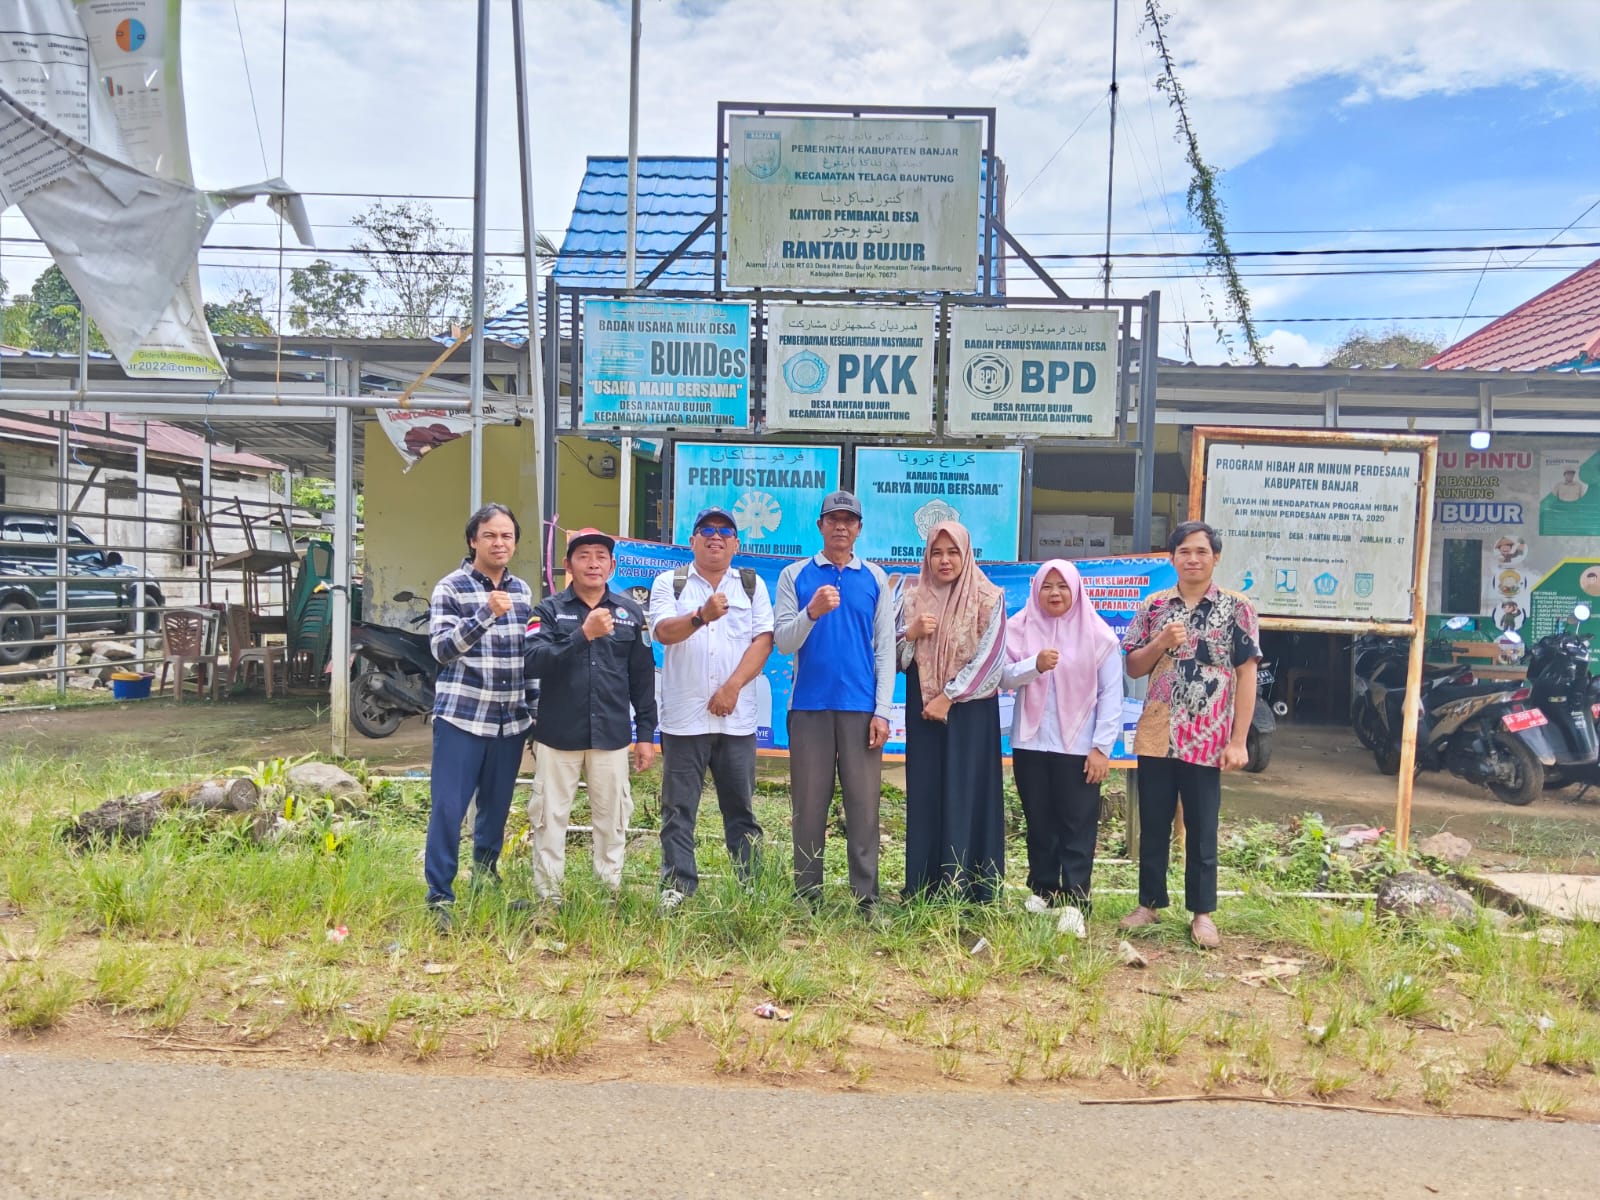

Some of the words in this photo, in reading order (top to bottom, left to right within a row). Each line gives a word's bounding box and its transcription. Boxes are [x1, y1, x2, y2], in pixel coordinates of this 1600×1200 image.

[791, 144, 855, 154] PEMERINTAH
[858, 146, 916, 155] KABUPATEN
[920, 147, 959, 156] BANJAR
[795, 171, 855, 181] KECAMATAN
[858, 172, 897, 182] TELAGA
[900, 174, 954, 183] BAUNTUNG
[790, 208, 832, 221] KANTOR
[834, 209, 890, 222] PEMBAKAL
[892, 211, 919, 223] DESA
[782, 240, 858, 260] RANTAU
[863, 242, 925, 261] BUJUR
[810, 270, 843, 278] Kabupaten
[844, 271, 864, 279] Banjar
[856, 263, 872, 271] Bujur
[932, 265, 961, 273] Bauntung
[599, 319, 635, 332] BADAN
[638, 320, 674, 333] USAHA
[676, 321, 706, 334] MILIK
[709, 322, 736, 335] DESA
[779, 335, 828, 346] PEMBERDAYAAN
[829, 335, 881, 347] KESEJAHTERAAN
[881, 336, 923, 348] MASYARAKAT
[964, 339, 993, 349] BADAN
[995, 340, 1083, 351] PERMUSYAWARATAN
[1084, 341, 1107, 352] DESA
[651, 340, 746, 377] BUMDes
[838, 353, 918, 395] PKK
[1021, 360, 1097, 394] BPD
[639, 381, 674, 396] MAJU
[620, 400, 643, 411] DESA
[645, 400, 680, 412] RANTAU
[683, 401, 712, 413] BUJUR
[811, 399, 831, 409] DESA
[832, 400, 863, 410] RANTAU
[865, 400, 890, 410] BUJUR
[993, 402, 1013, 412] DESA
[1015, 403, 1046, 412] RANTAU
[1047, 403, 1073, 413] BUJUR
[594, 411, 648, 423] KECAMATAN
[651, 412, 683, 424] TELAGA
[686, 414, 735, 425] BAUNTUNG
[789, 409, 836, 419] KECAMATAN
[837, 410, 866, 420] TELAGA
[867, 410, 910, 421] BAUNTUNG
[971, 412, 1018, 422] KECAMATAN
[1019, 412, 1048, 422] TELAGA
[1049, 413, 1093, 423] BAUNTUNG
[1464, 452, 1532, 469] PINTU
[1216, 458, 1263, 471] PROGRAM
[1266, 460, 1295, 473] HIBAH
[1298, 461, 1314, 474] AIR
[1317, 462, 1351, 475] MINUM
[1354, 464, 1410, 478] PERDESAAN
[688, 467, 826, 489] PERPUSTAKAAN
[906, 471, 938, 481] KARANG
[939, 471, 969, 481] TARUNA
[1449, 475, 1500, 487] BANJAR
[913, 482, 945, 495] MUDA
[1264, 477, 1318, 491] KABUPATEN
[1321, 479, 1359, 492] BANJAR
[1437, 488, 1495, 499] AUNTUNG
[1222, 497, 1257, 506] WILAYAH
[1272, 499, 1330, 509] MENDAPATKAN
[1332, 502, 1372, 511] PROGRAM
[1373, 503, 1399, 513] HIBAH
[1234, 508, 1248, 516] AIR
[1250, 509, 1278, 518] MINUM
[1279, 510, 1326, 519] PERDESAAN
[1328, 512, 1349, 521] APBN
[1366, 514, 1385, 522] 2020
[1441, 502, 1523, 524] BUJUR
[1228, 529, 1249, 537] TELAGA
[1250, 530, 1281, 539] BAUNTUNG
[1288, 531, 1304, 540] DESA
[1308, 532, 1331, 541] RANTAU
[1332, 533, 1352, 542] BUJUR
[1359, 535, 1384, 544] JUMLAH
[1384, 536, 1393, 544] KK
[773, 544, 802, 555] BUJUR
[891, 546, 914, 557] DESA
[1265, 554, 1291, 562] Program
[618, 567, 666, 578] KABUPA
[1095, 576, 1149, 586] KESEMPATAN
[1107, 588, 1139, 597] HADIAH
[1101, 600, 1128, 610] PAJAK
